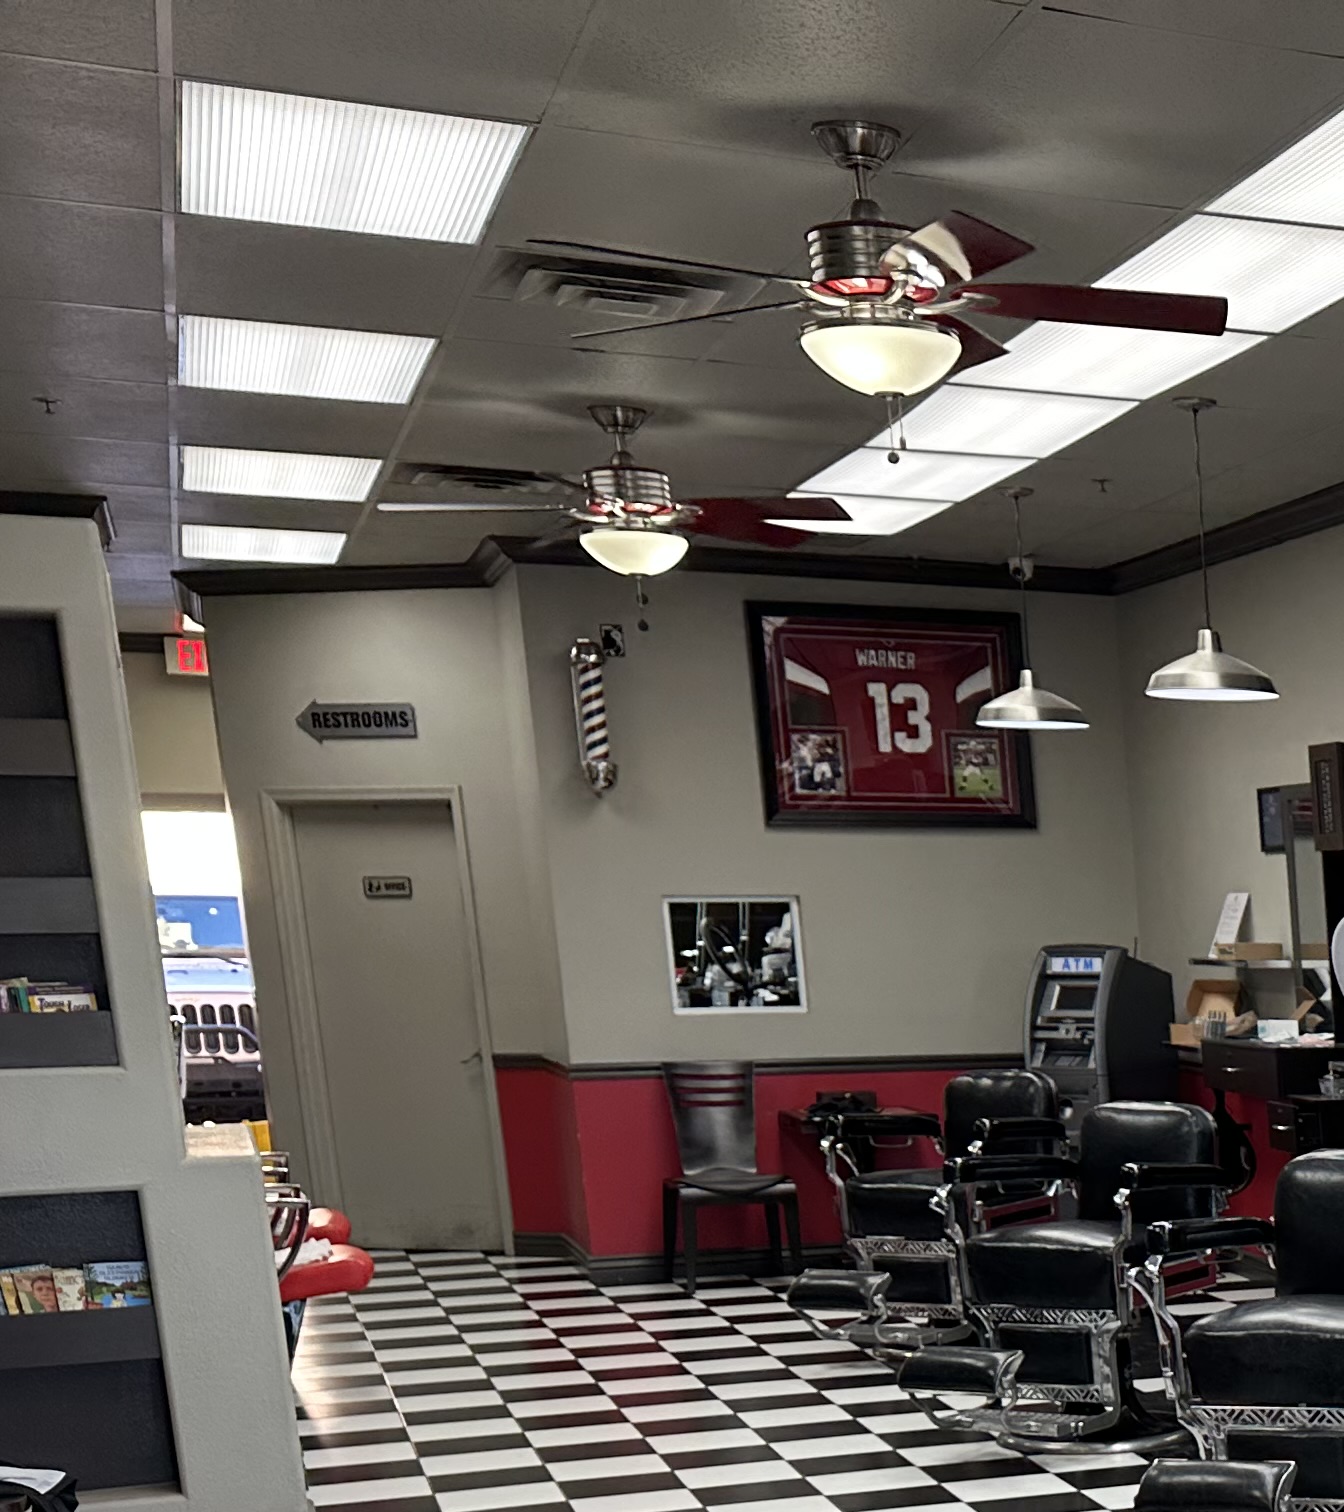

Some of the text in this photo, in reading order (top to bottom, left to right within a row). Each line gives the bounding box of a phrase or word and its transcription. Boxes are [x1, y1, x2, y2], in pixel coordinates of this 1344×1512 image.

[855, 648, 916, 670] WARNER
[311, 710, 409, 729] RESTROOMS
[866, 682, 933, 753] 13
[1062, 958, 1093, 971] ATM
